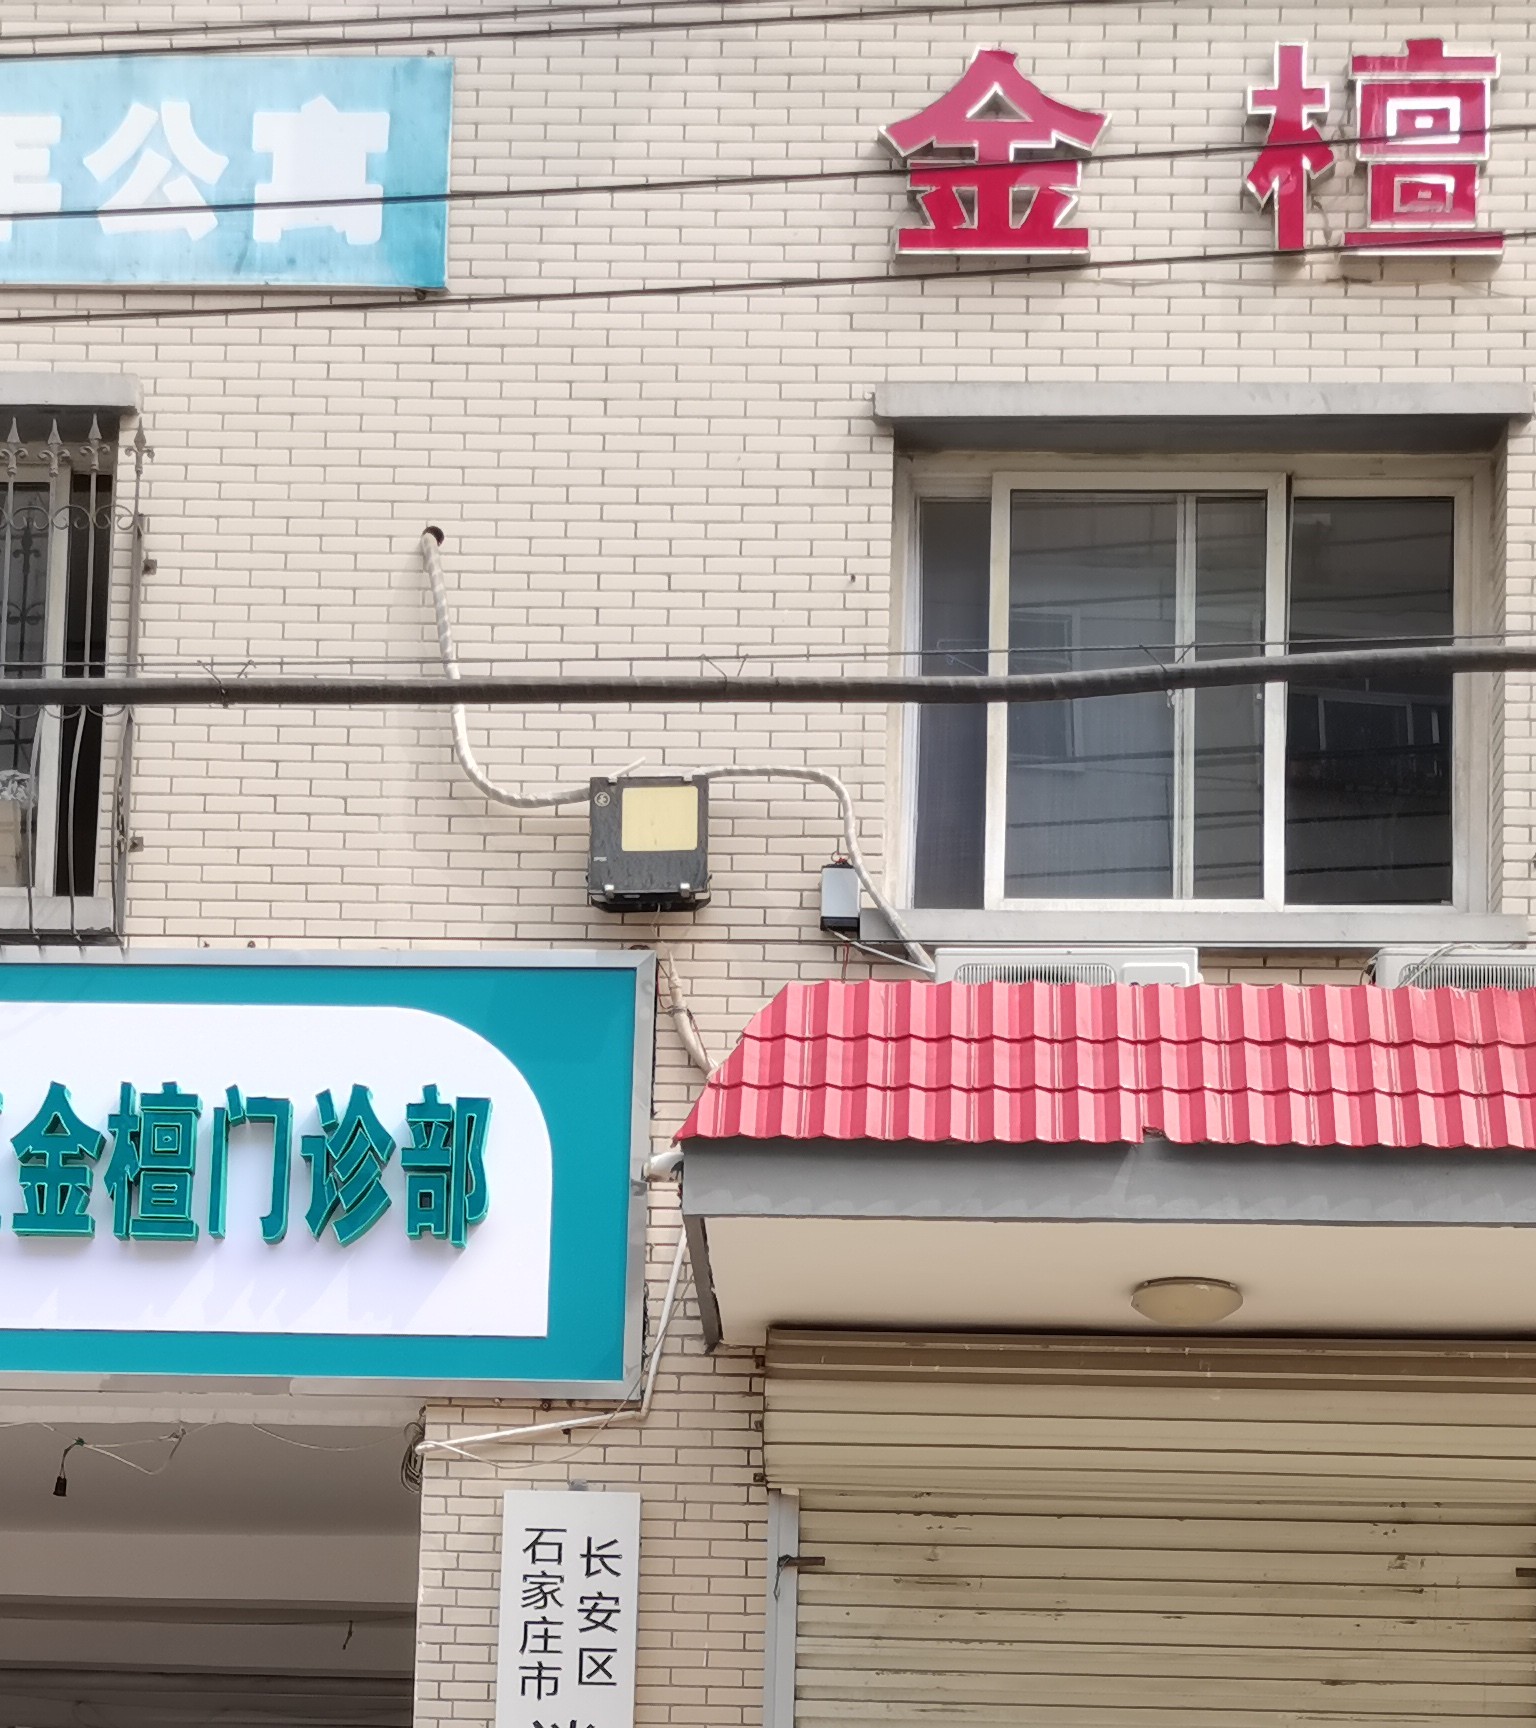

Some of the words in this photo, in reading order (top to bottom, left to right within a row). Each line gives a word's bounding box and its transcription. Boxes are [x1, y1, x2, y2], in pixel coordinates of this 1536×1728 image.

[517, 1526, 569, 1702] 石家庄市
[575, 1536, 622, 1688] 长安区
